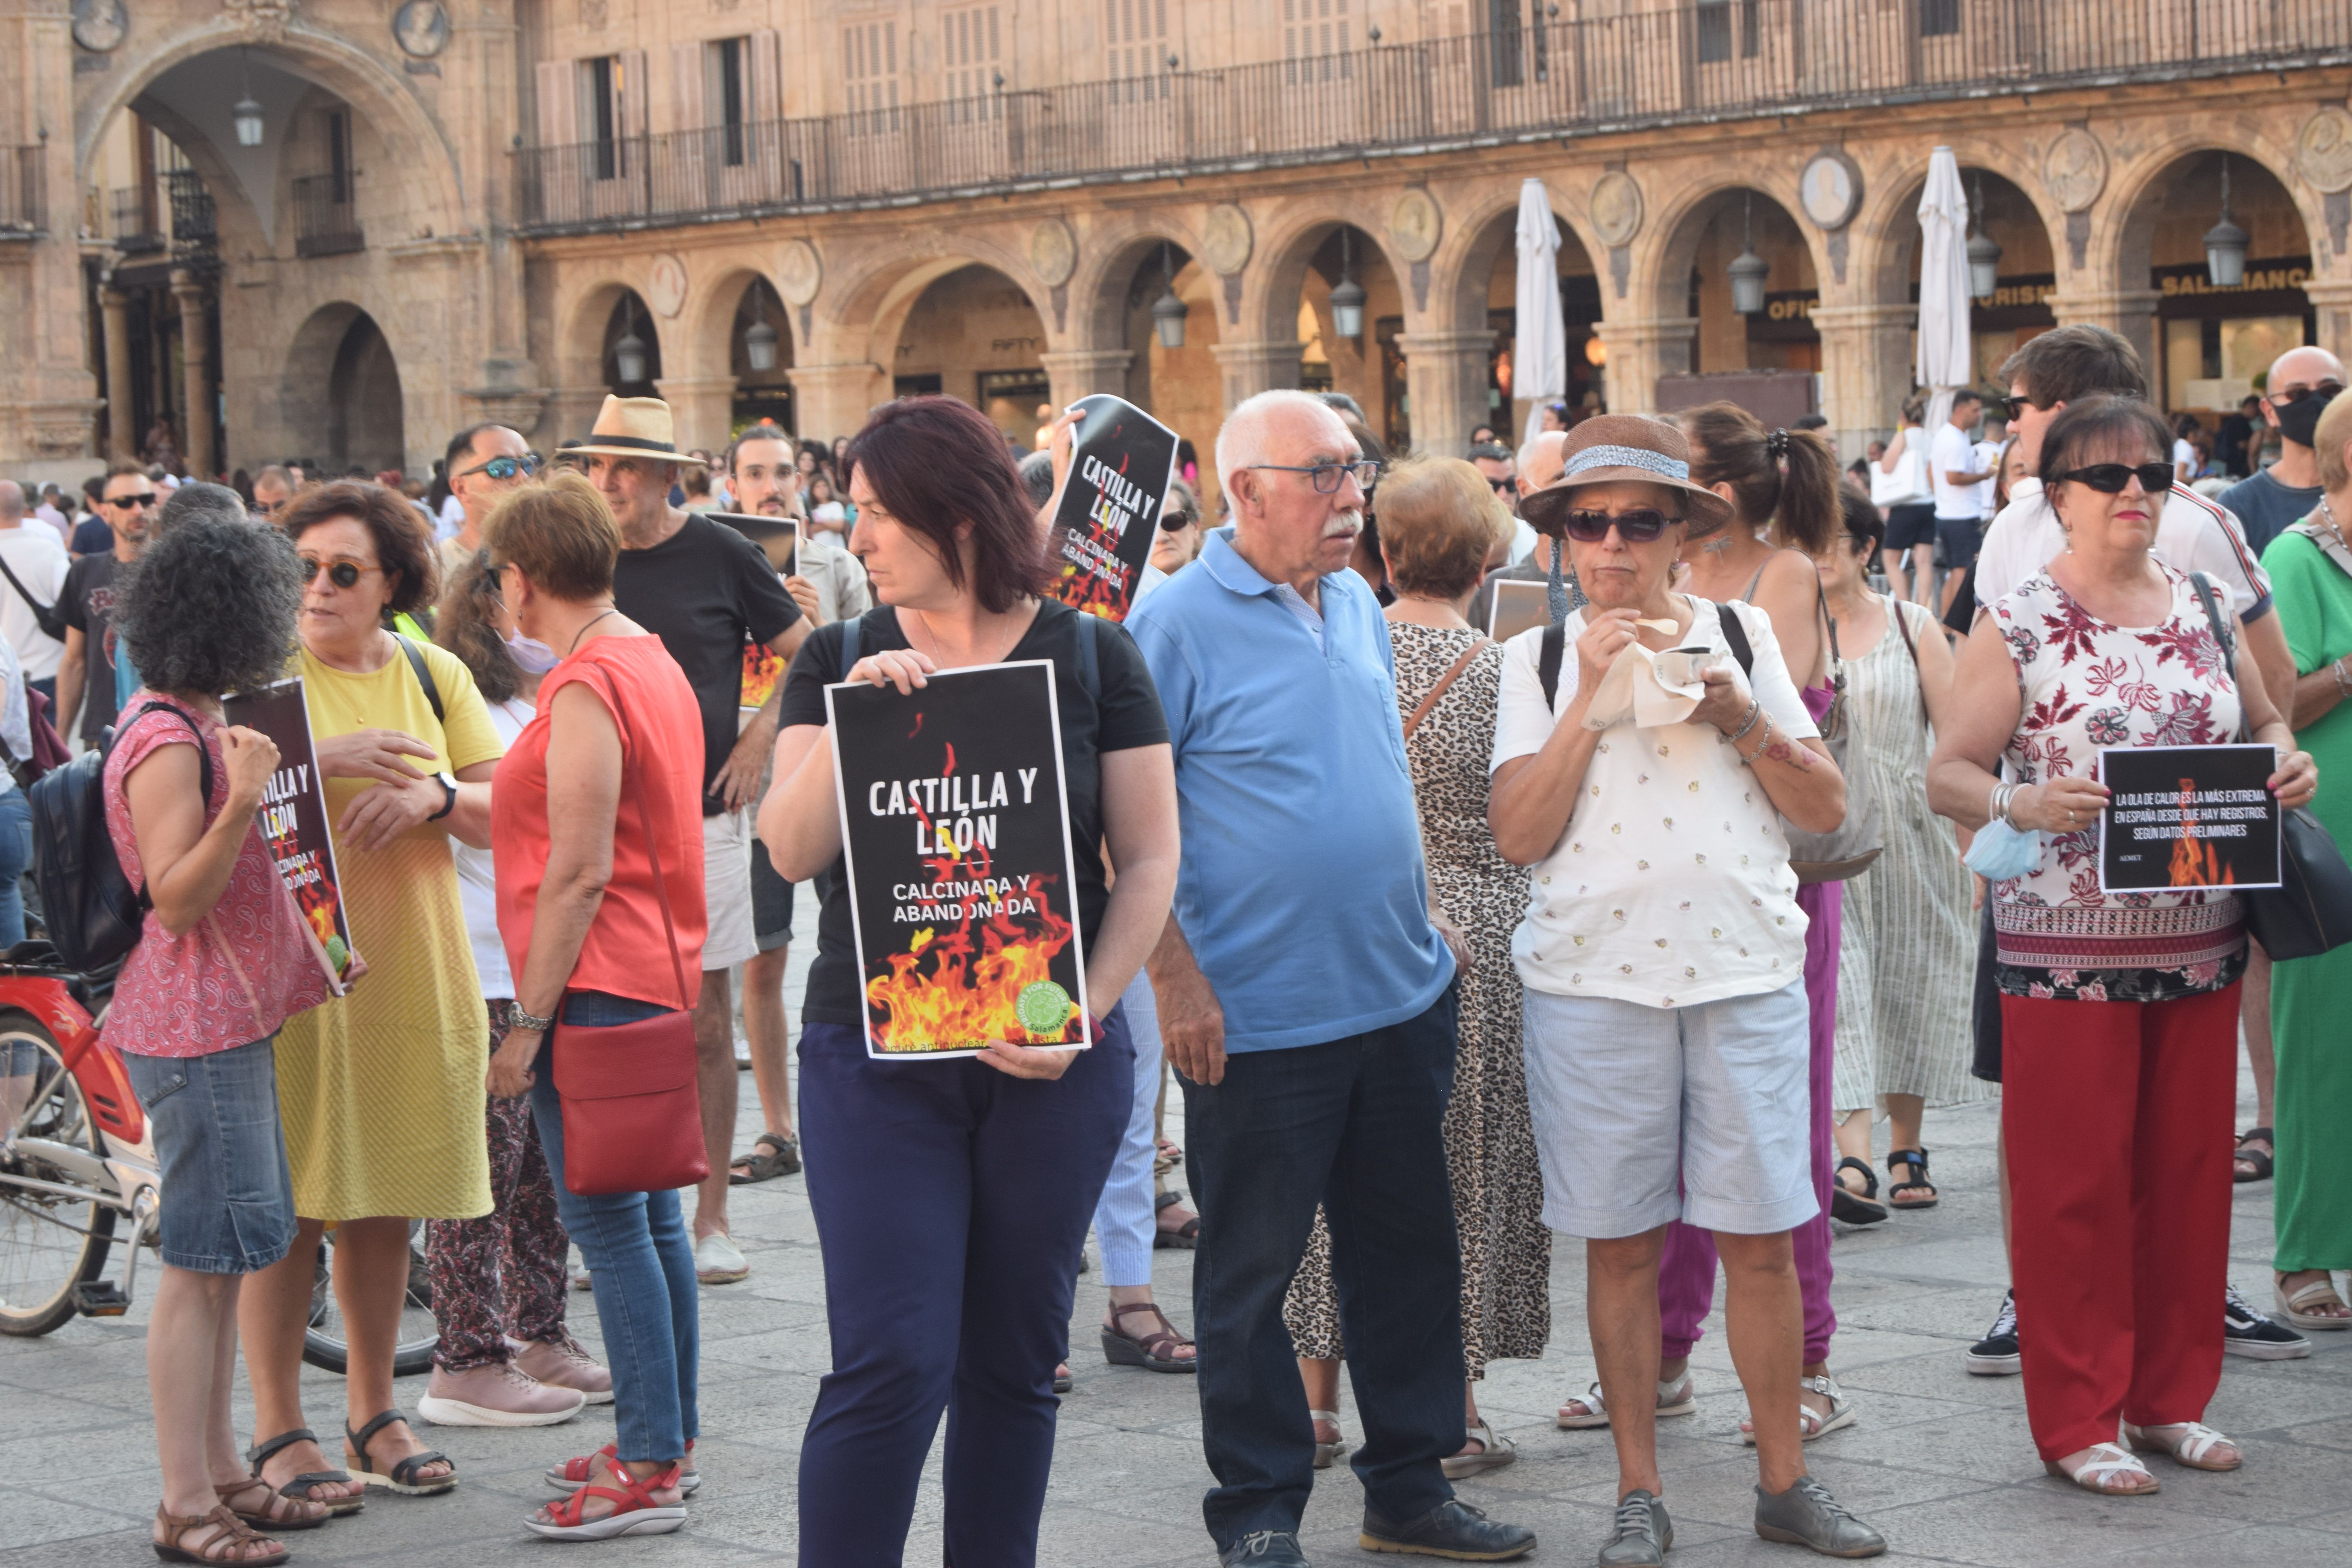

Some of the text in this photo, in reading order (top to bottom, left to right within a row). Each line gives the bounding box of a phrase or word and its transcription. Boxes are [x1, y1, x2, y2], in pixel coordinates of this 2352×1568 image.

[2161, 267, 2313, 297] SALANC
[1082, 455, 1156, 519] CASTILLA Y
[1089, 493, 1131, 536] LEÓN
[1067, 528, 1129, 573] CALCINADA Y
[296, 764, 308, 793] Y
[869, 767, 1038, 816] CASTILLA Y
[2116, 789, 2267, 806] LA OLA DE CALOR ES LA MÁS EXTREMA
[262, 799, 298, 838] LEÓN
[2114, 806, 2269, 824] EN ESPAÑA DESDE QUE HAY REGISTROS,
[916, 809, 997, 855] LEÓN
[2132, 824, 2247, 840] SEGÚN DATOS PRELIMINARES
[307, 849, 315, 864] Y
[893, 874, 1030, 900] CALCINADA Y
[1018, 983, 1069, 1027] FRIDAYS FOR FUTURE
[1029, 1009, 1068, 1033] Salamanca
